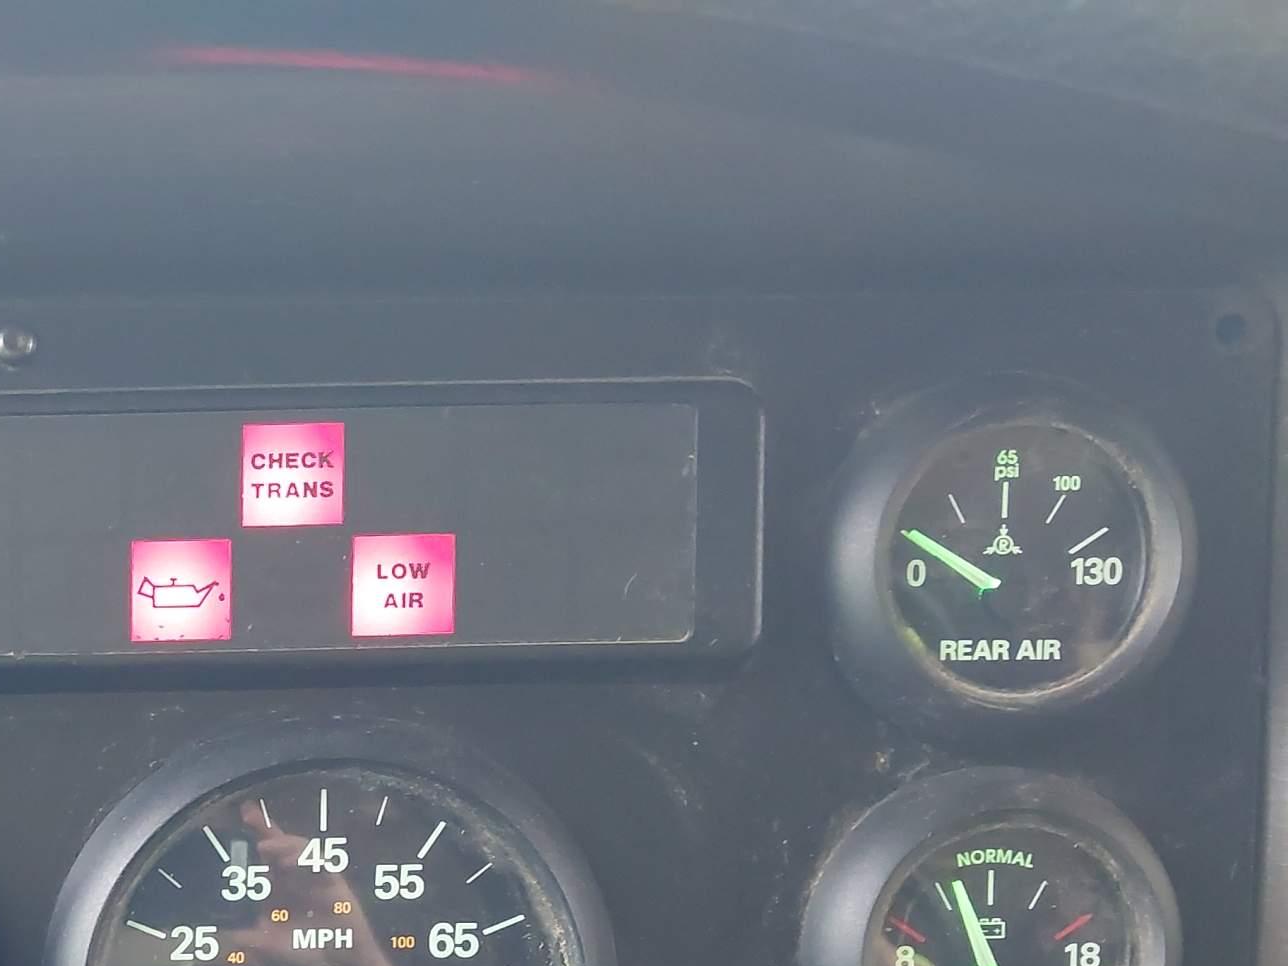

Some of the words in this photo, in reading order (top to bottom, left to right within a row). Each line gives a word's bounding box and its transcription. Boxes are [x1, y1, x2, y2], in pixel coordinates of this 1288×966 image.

[250, 450, 335, 470] CHECK
[996, 450, 1018, 465] 65
[994, 463, 1019, 481] psi
[251, 480, 335, 499] TRANS
[1052, 475, 1081, 491] 100
[376, 562, 431, 580] LOW
[906, 559, 927, 587] 0
[1070, 557, 1123, 585] 130
[384, 592, 424, 609] AIR
[939, 639, 1010, 661] REAR
[1015, 639, 1061, 660] AIR
[297, 837, 350, 873] 45
[955, 848, 1035, 869] NORMAL
[220, 865, 272, 901] 35
[373, 863, 425, 900] 55
[270, 909, 289, 922] 60
[333, 901, 352, 914] 80
[169, 925, 219, 961] 25
[292, 928, 353, 949] MPH
[390, 936, 415, 949] 100
[427, 922, 479, 959] 65
[227, 951, 245, 965] 40
